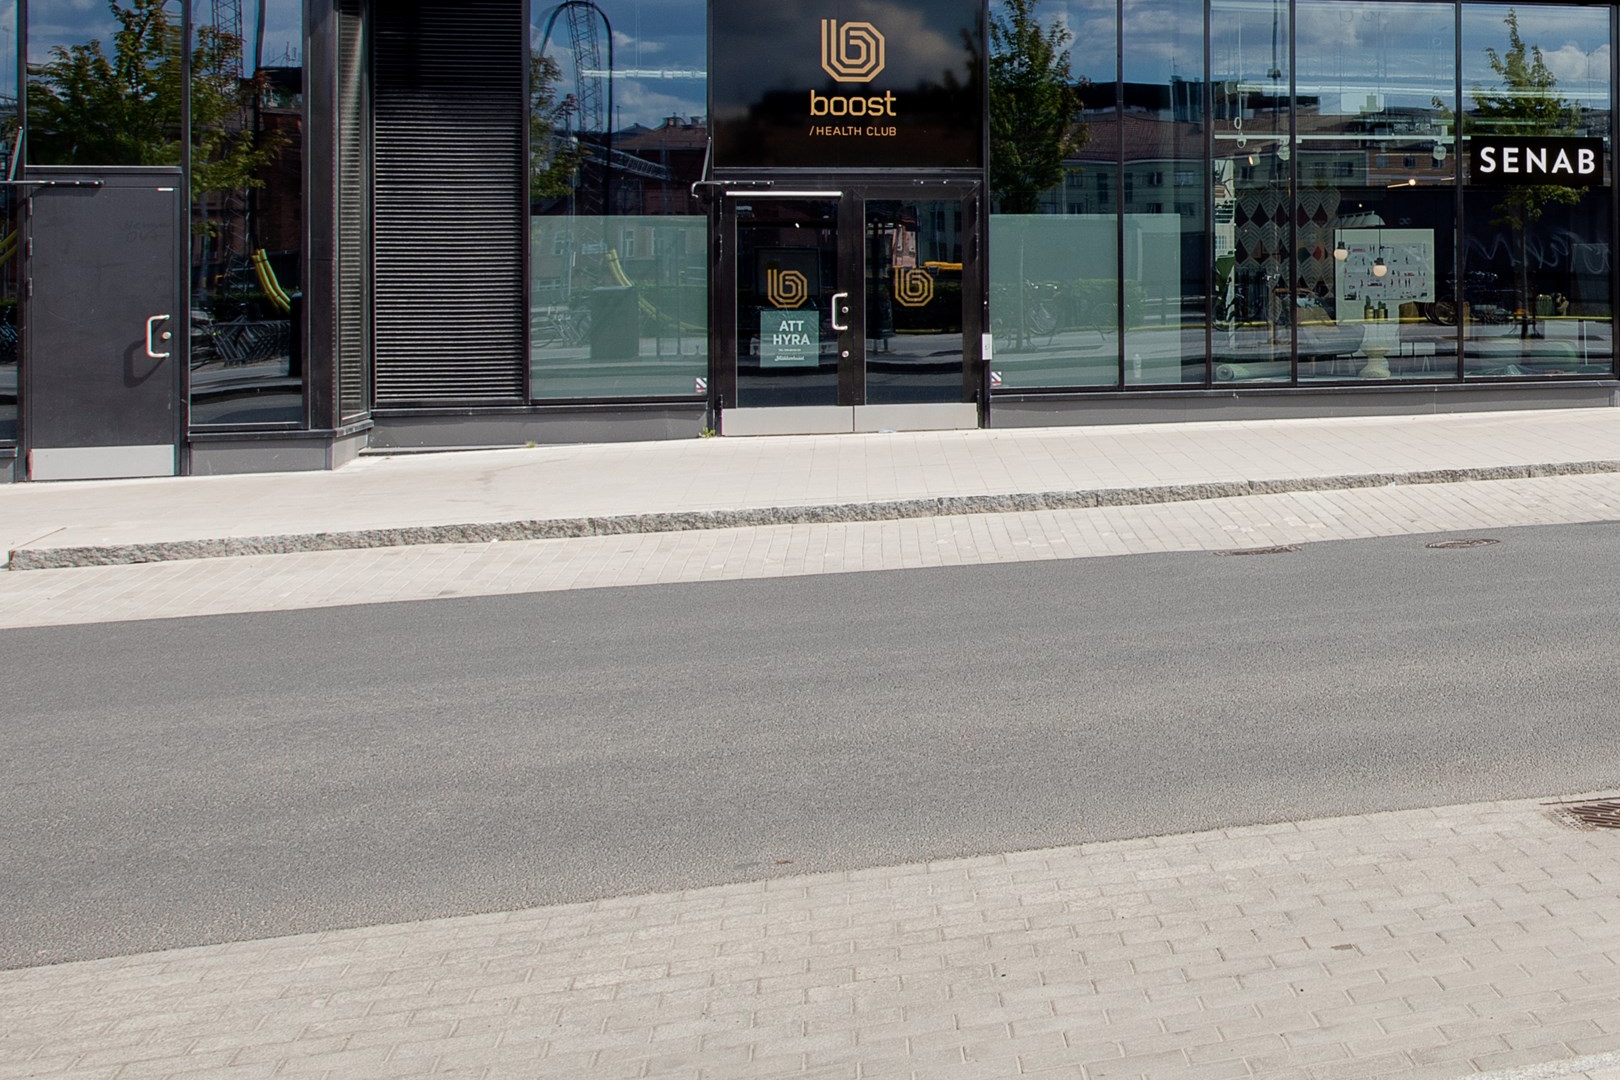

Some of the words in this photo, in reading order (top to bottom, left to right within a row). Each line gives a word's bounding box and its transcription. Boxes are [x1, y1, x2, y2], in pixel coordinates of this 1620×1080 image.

[810, 89, 897, 116] boost
[866, 126, 897, 136] CLUB
[1480, 146, 1595, 174] SENAB
[779, 320, 804, 332] ATT
[773, 334, 811, 346] HYRA
